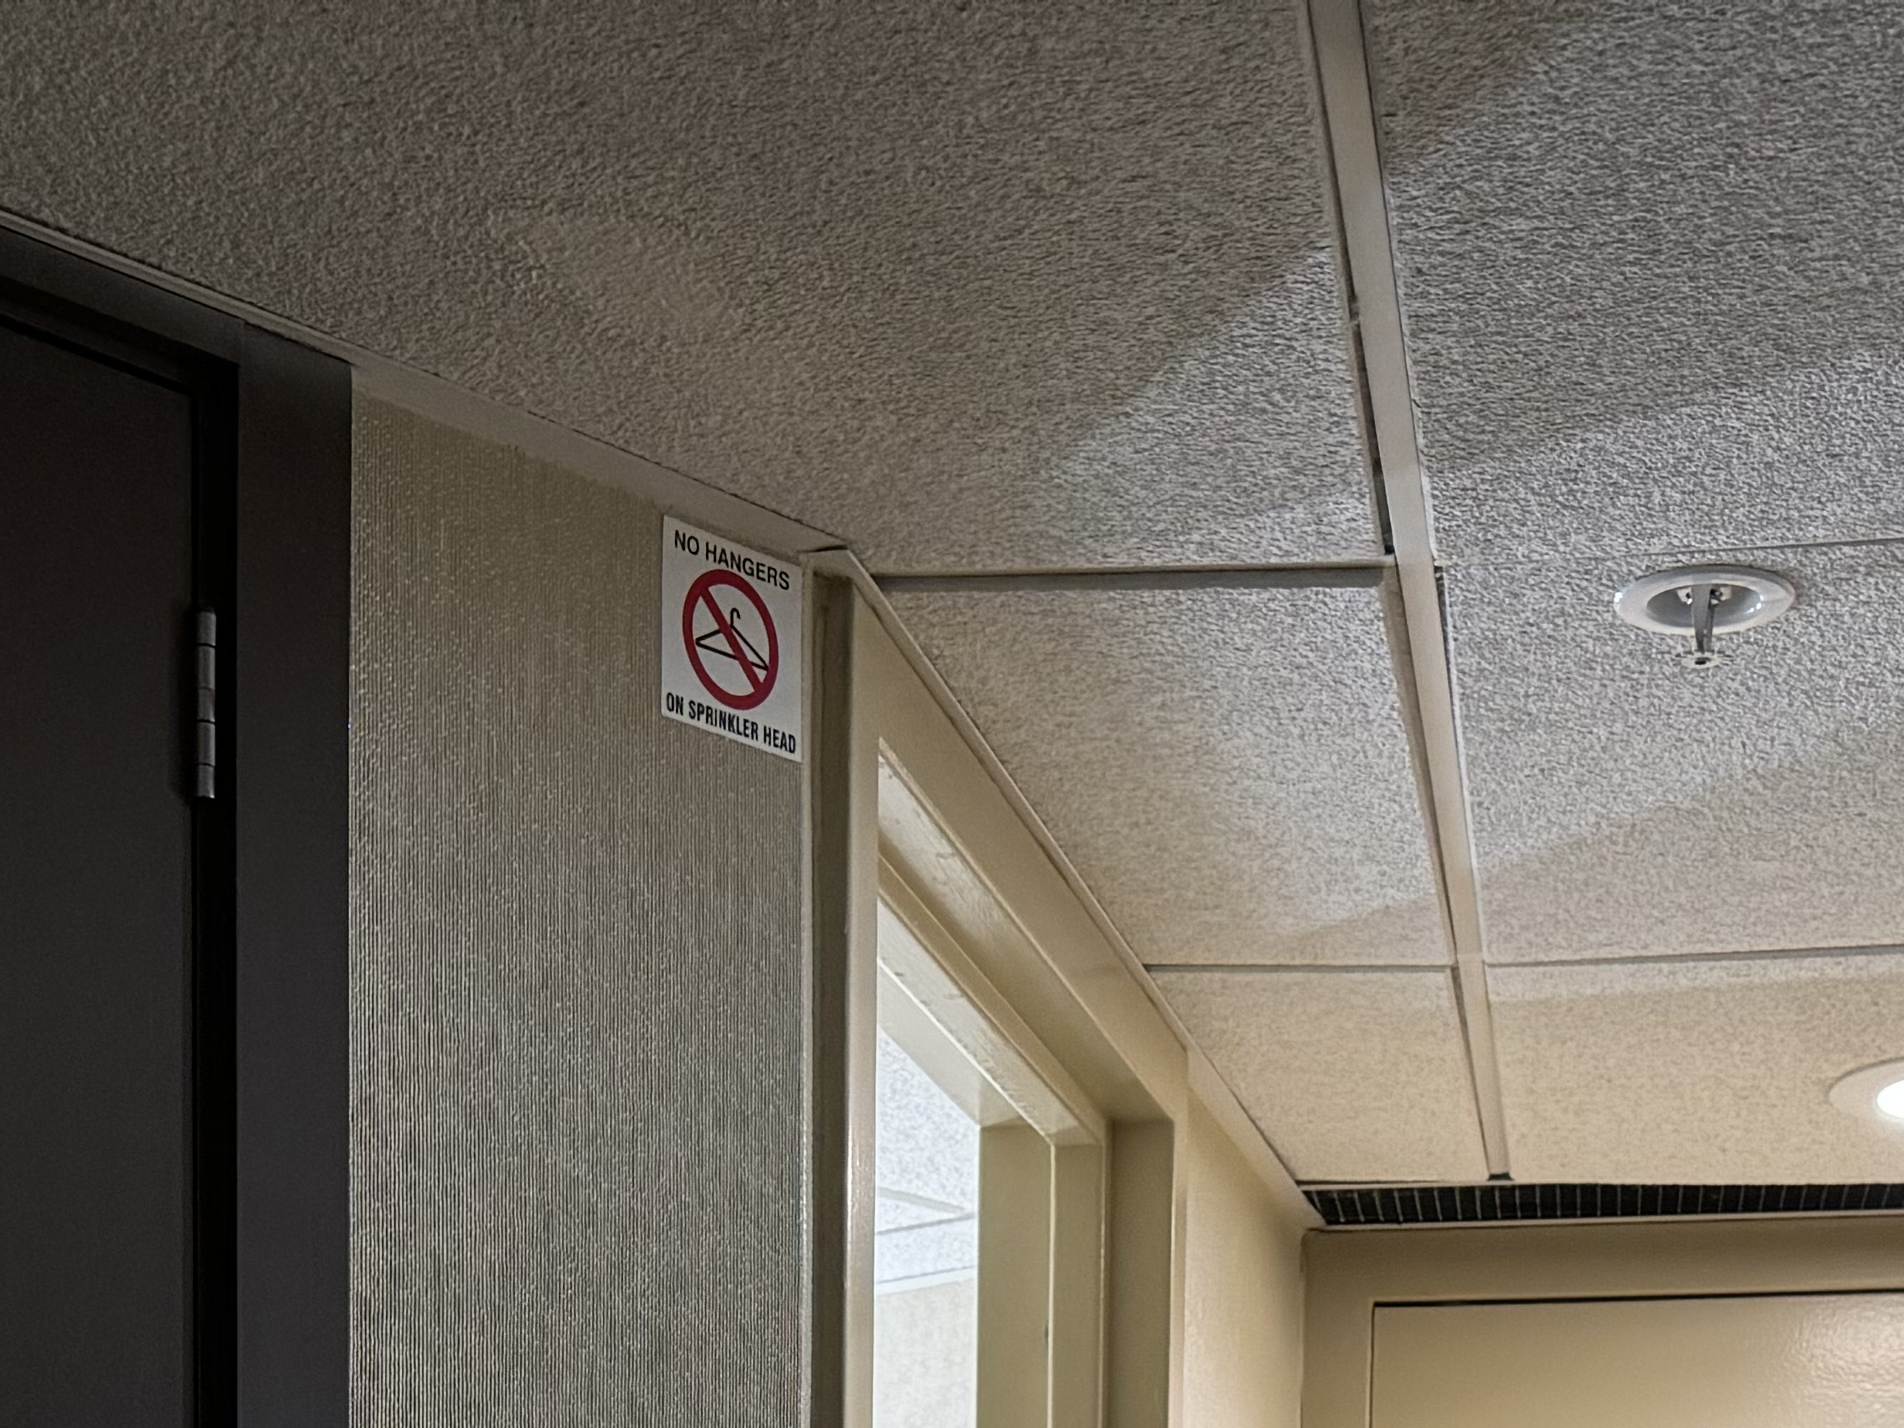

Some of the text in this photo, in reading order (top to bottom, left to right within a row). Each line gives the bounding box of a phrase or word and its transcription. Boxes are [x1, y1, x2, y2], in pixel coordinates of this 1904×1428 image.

[674, 529, 790, 591] NO HANGERS
[666, 692, 796, 754] ON SPRINKLER HEAD
